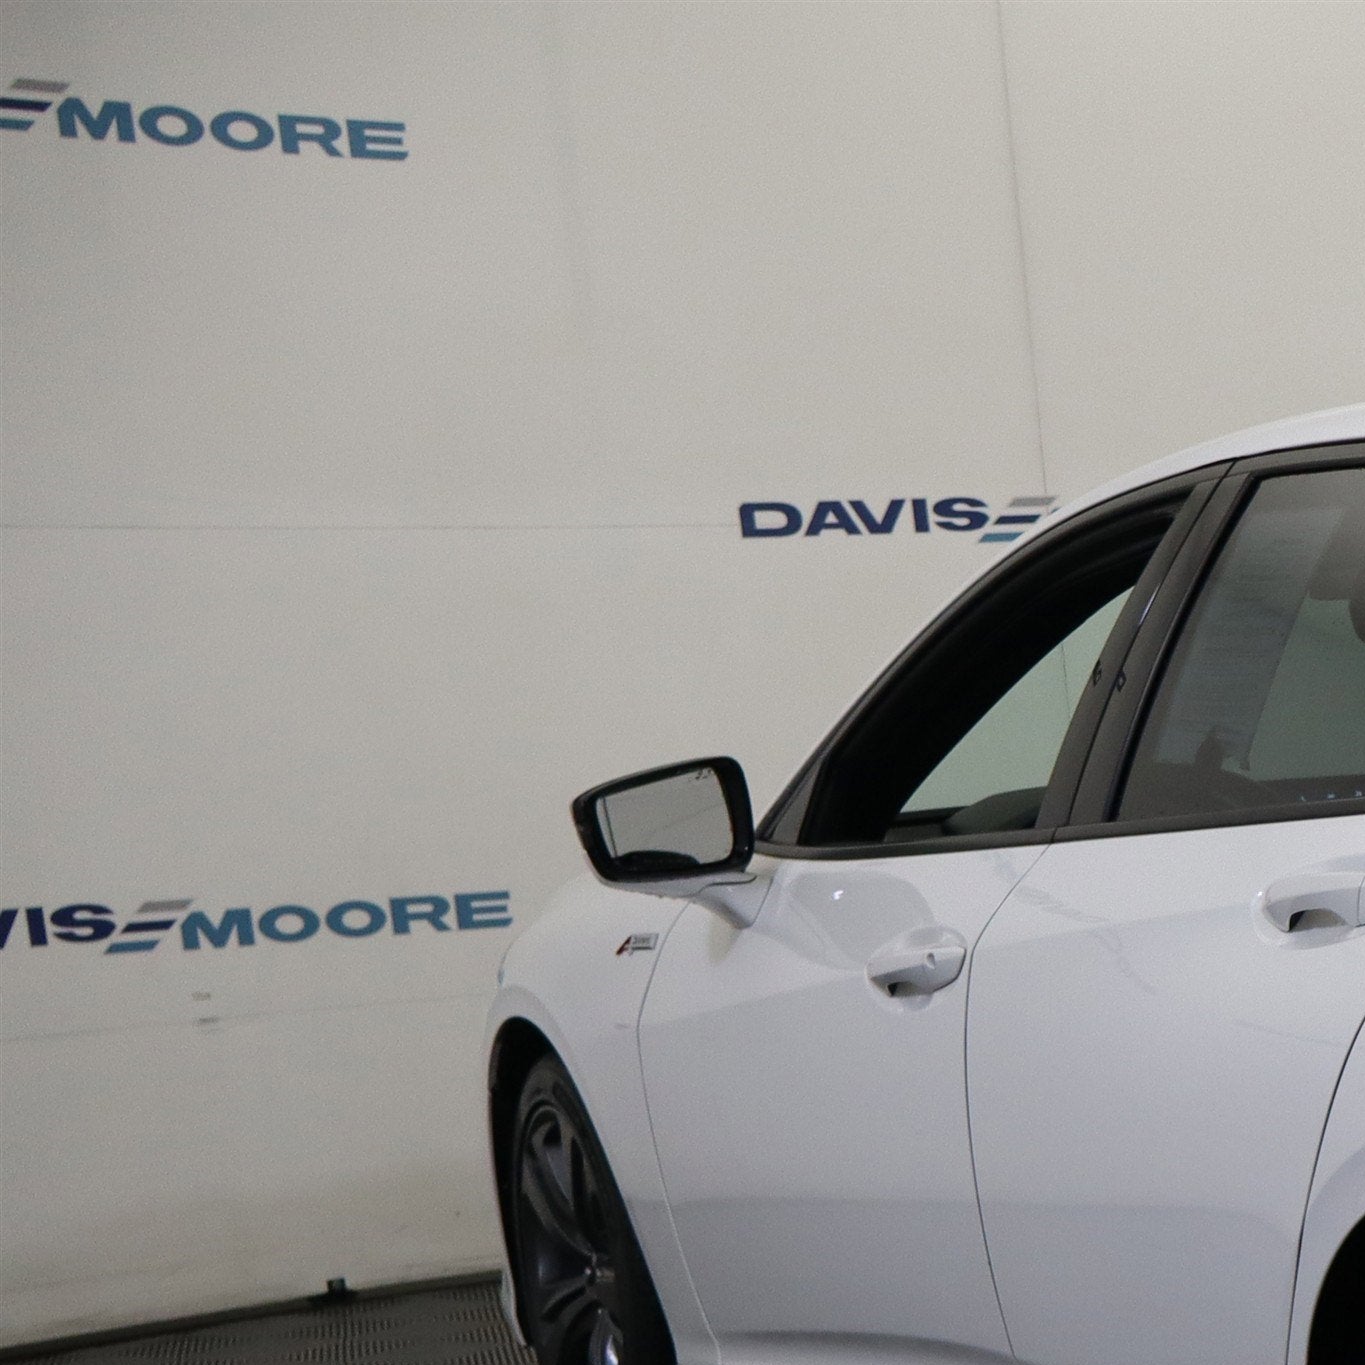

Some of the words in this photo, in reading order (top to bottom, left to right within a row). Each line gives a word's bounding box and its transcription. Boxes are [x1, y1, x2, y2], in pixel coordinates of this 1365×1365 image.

[56, 98, 409, 161] MOORE
[738, 497, 990, 539] DAVIS
[179, 890, 513, 951] MOORE
